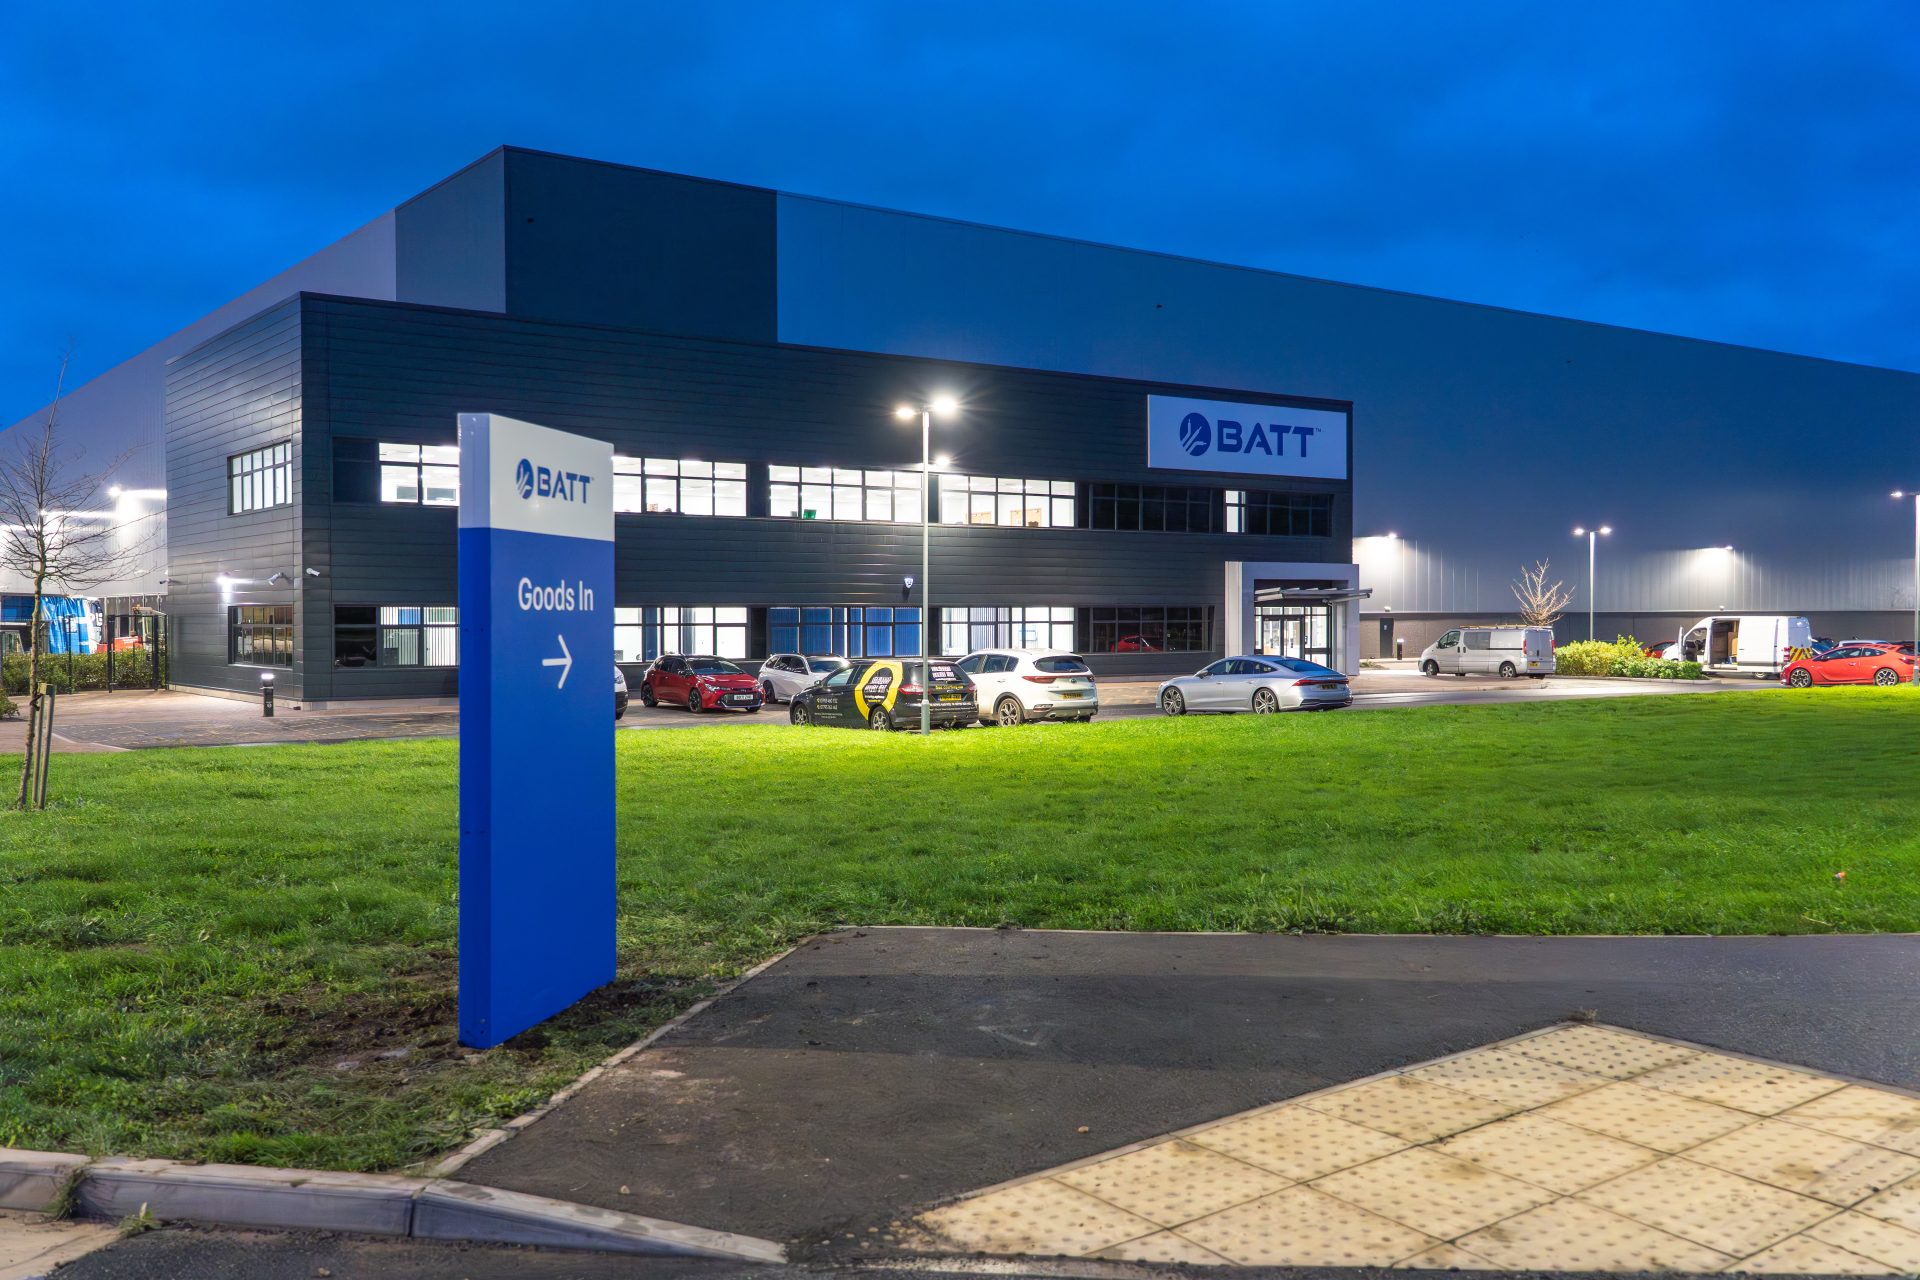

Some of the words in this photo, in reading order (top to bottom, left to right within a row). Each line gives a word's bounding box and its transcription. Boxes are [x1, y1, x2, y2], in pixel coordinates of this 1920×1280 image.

[1217, 419, 1314, 458] BATT
[537, 466, 591, 504] BATT
[518, 576, 575, 612] Goods
[579, 580, 594, 611] In
